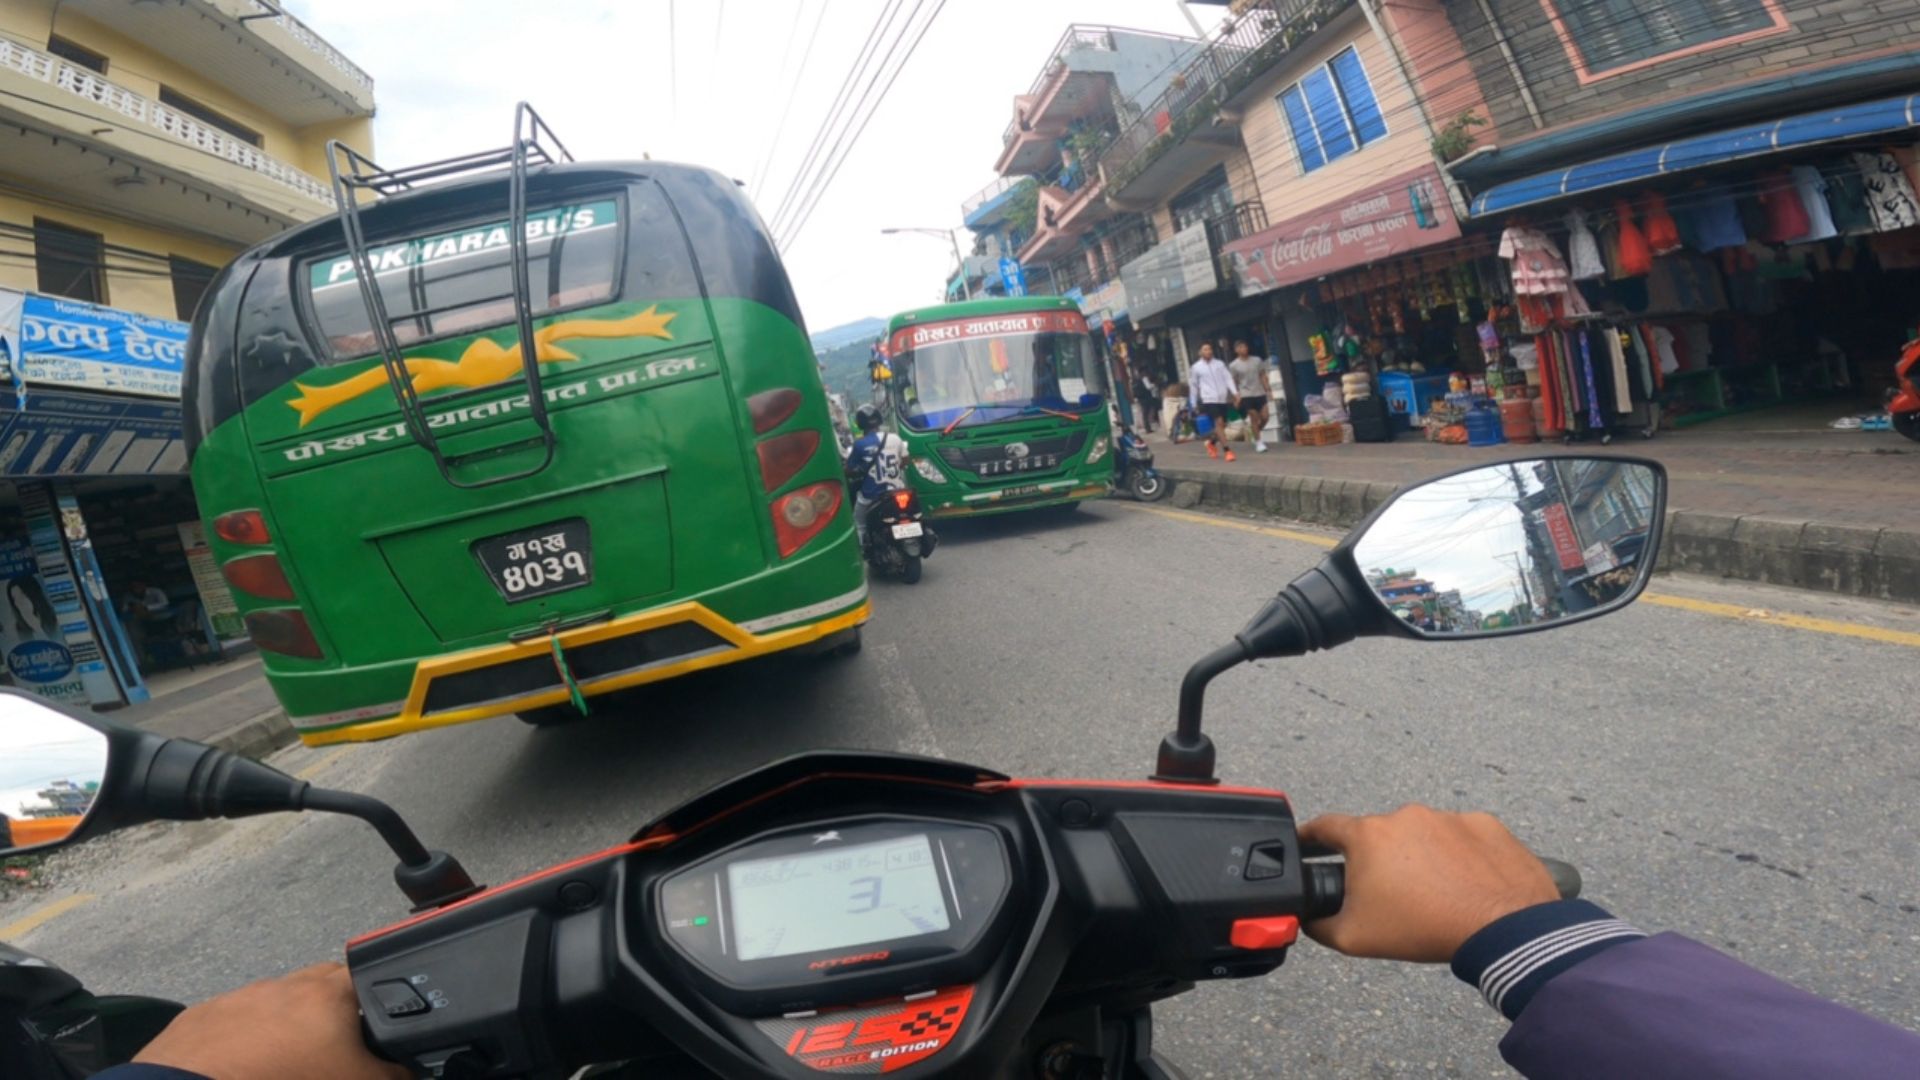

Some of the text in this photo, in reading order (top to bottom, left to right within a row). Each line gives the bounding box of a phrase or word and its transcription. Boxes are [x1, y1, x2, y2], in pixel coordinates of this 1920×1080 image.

[525, 208, 595, 237] BUS
[914, 325, 960, 343] पोखरा
[965, 317, 1027, 335] यातायात
[283, 422, 407, 462] पोखरा
[503, 551, 586, 593] ४०३१
[848, 875, 882, 915] 3
[869, 1038, 940, 1060] EDITION
